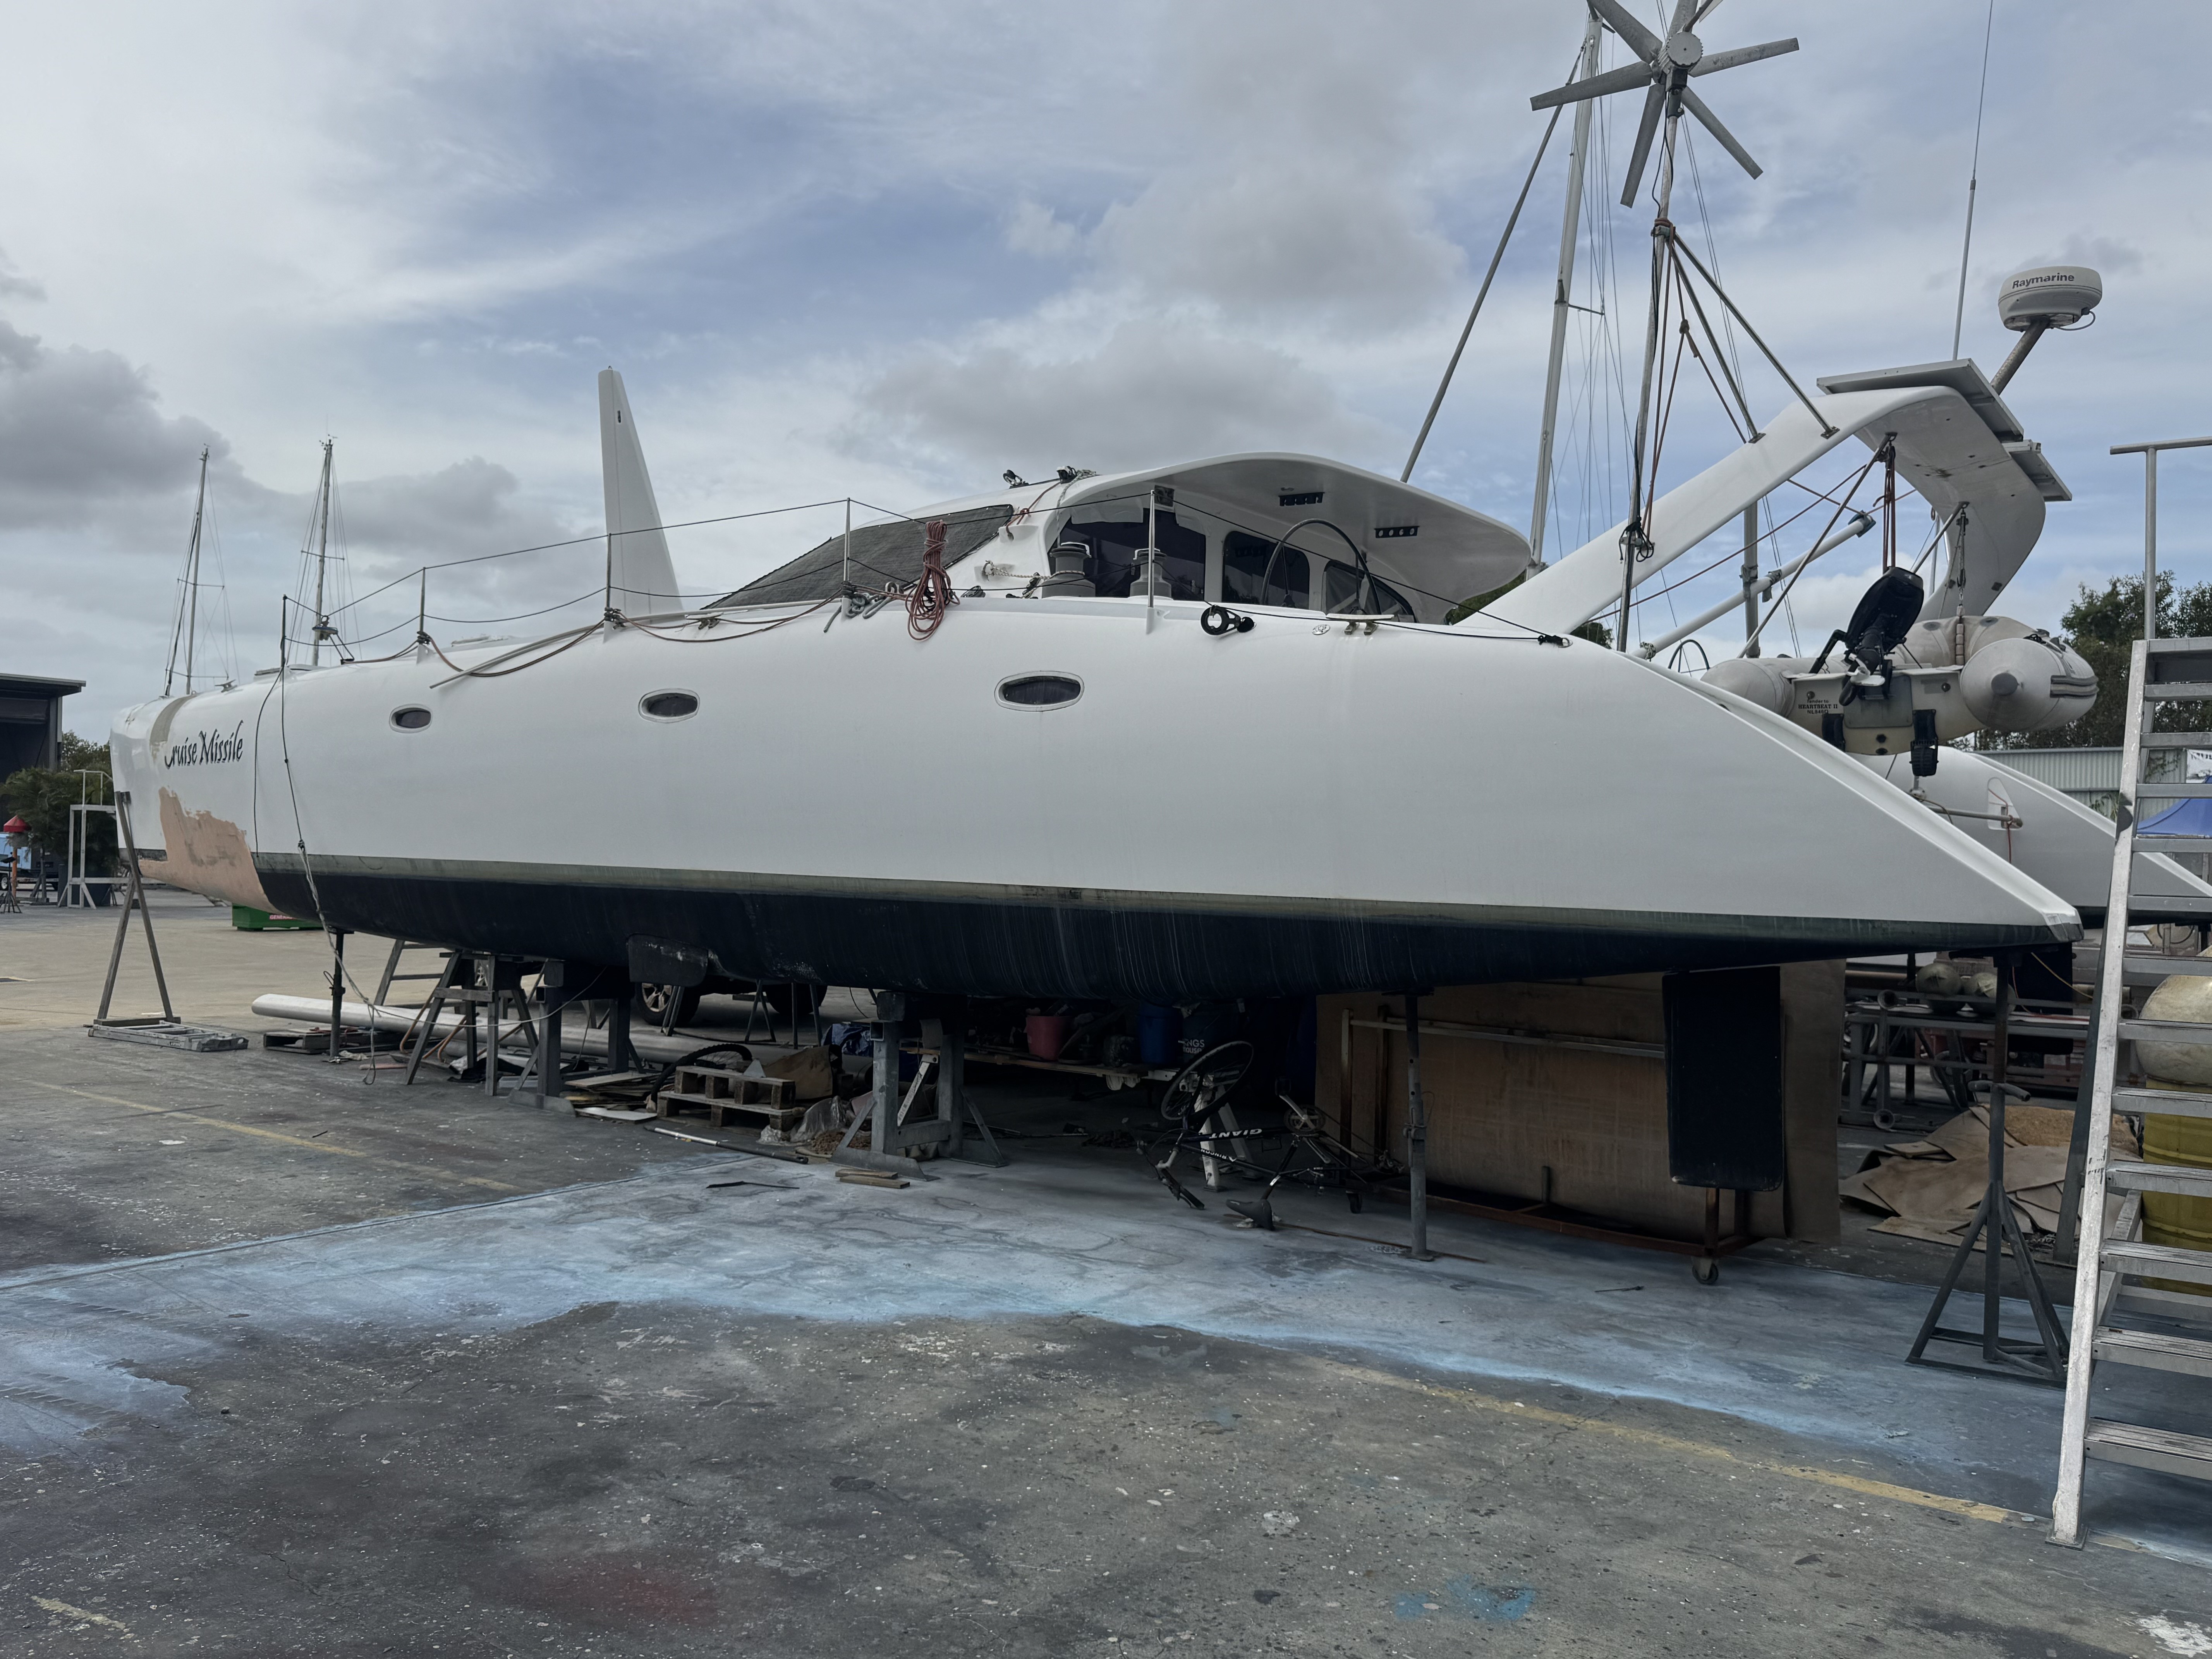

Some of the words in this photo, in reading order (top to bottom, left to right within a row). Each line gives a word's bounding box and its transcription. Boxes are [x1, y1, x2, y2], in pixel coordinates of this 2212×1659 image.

[2012, 272, 2075, 289] Raymarine
[199, 719, 244, 765] Missile
[1209, 1128, 1262, 1139] GIANT
[1200, 1149, 1227, 1160] RINCON
